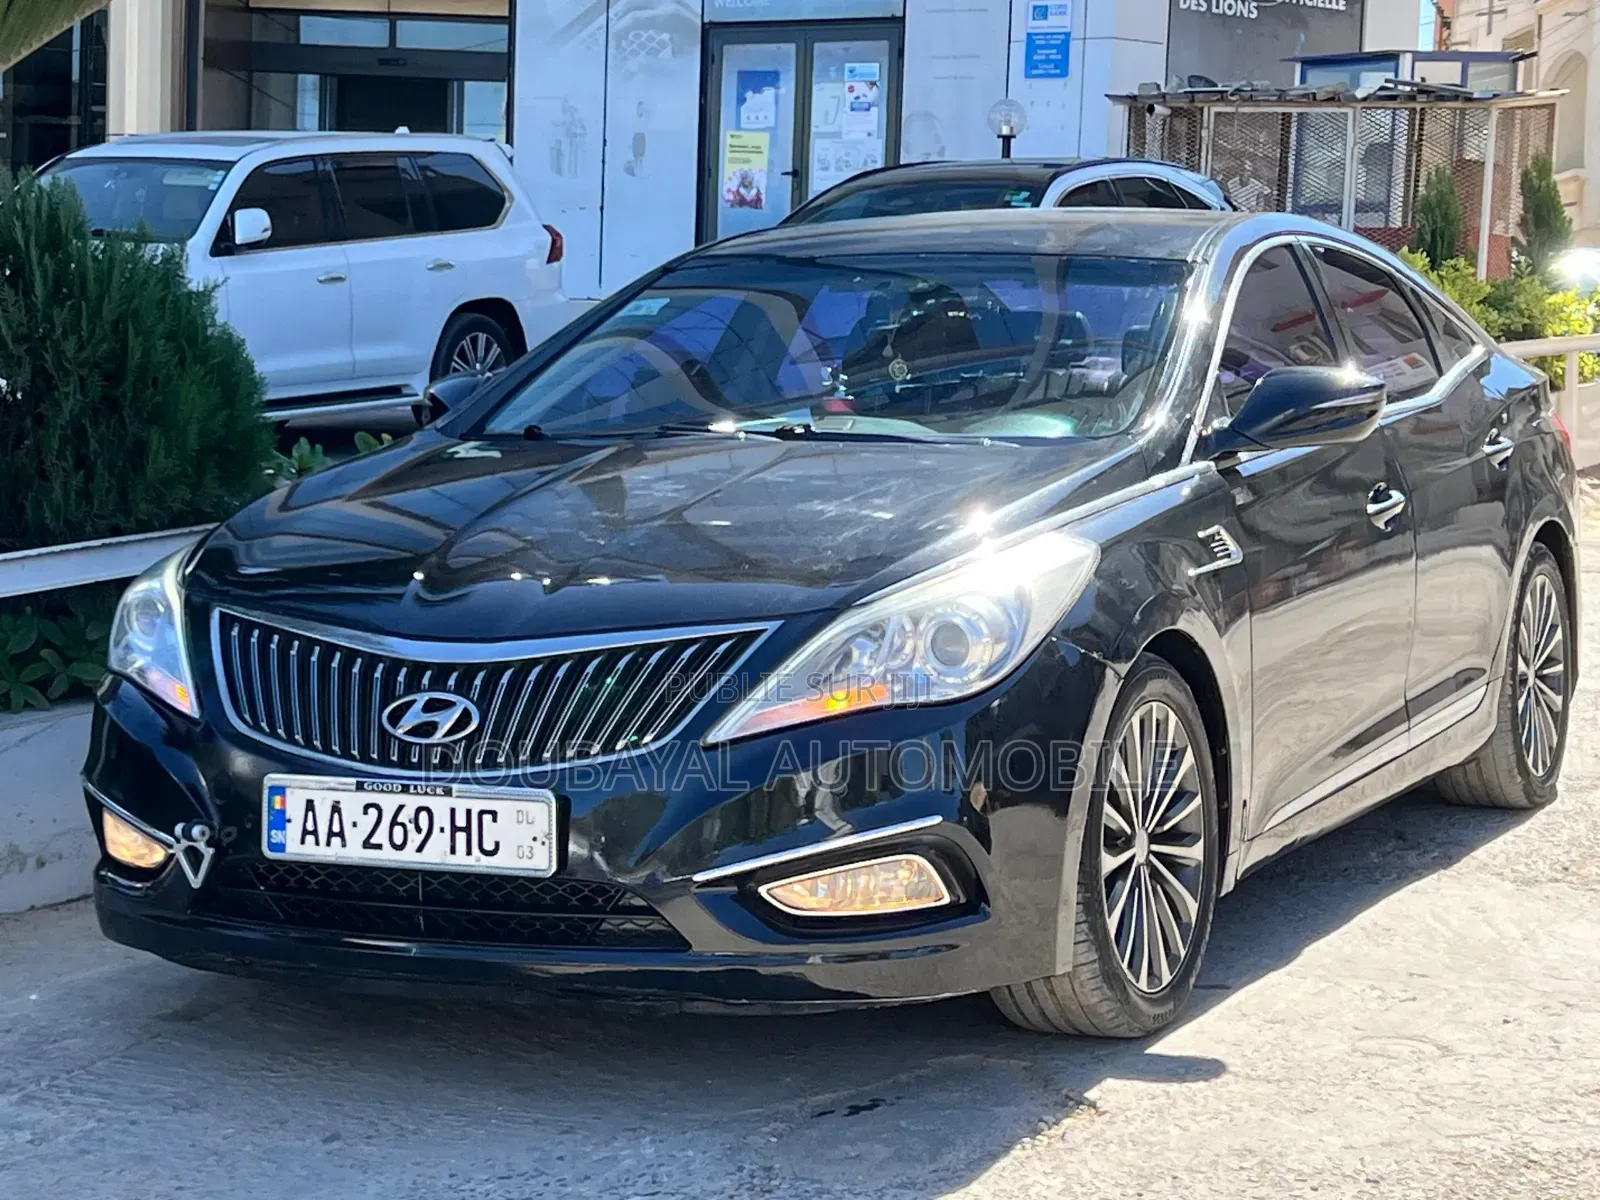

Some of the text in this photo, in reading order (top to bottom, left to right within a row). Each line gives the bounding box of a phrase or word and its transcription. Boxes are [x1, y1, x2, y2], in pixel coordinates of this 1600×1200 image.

[714, 0, 771, 9] WELCOE
[1212, 0, 1258, 19] LIONS
[363, 780, 445, 796] GOOD LUCK
[270, 828, 286, 844] SN
[516, 844, 535, 860] 03
